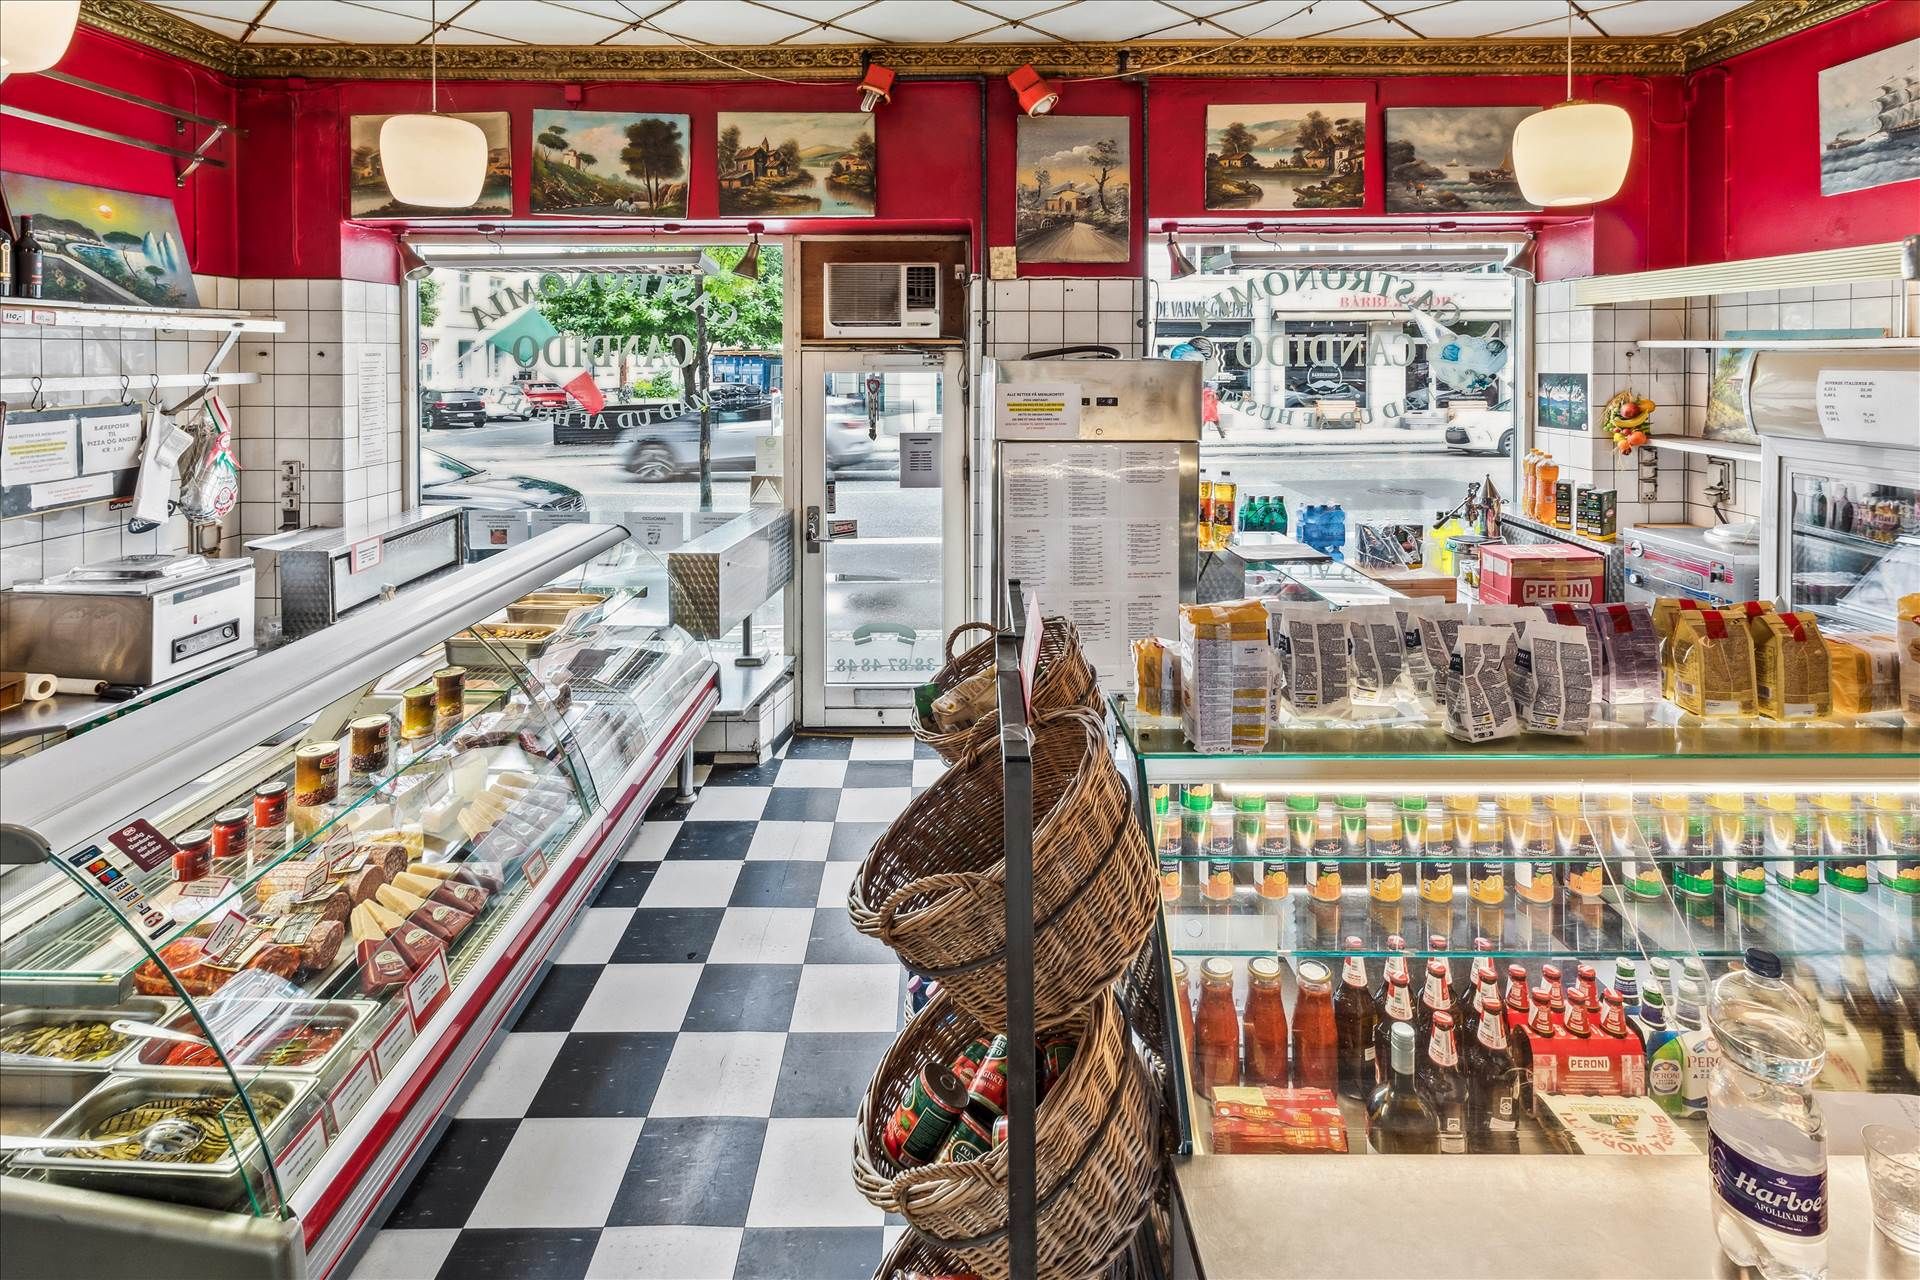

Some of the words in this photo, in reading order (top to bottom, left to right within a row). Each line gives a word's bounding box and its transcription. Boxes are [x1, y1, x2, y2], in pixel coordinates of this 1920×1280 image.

[1525, 583, 1590, 599] PERONI
[113, 882, 129, 893] VISA
[124, 891, 140, 902] VISA
[1570, 1059, 1608, 1069] PERONI
[1734, 1171, 1822, 1213] Harboe
[1754, 1201, 1809, 1223] APOLLINARIS
